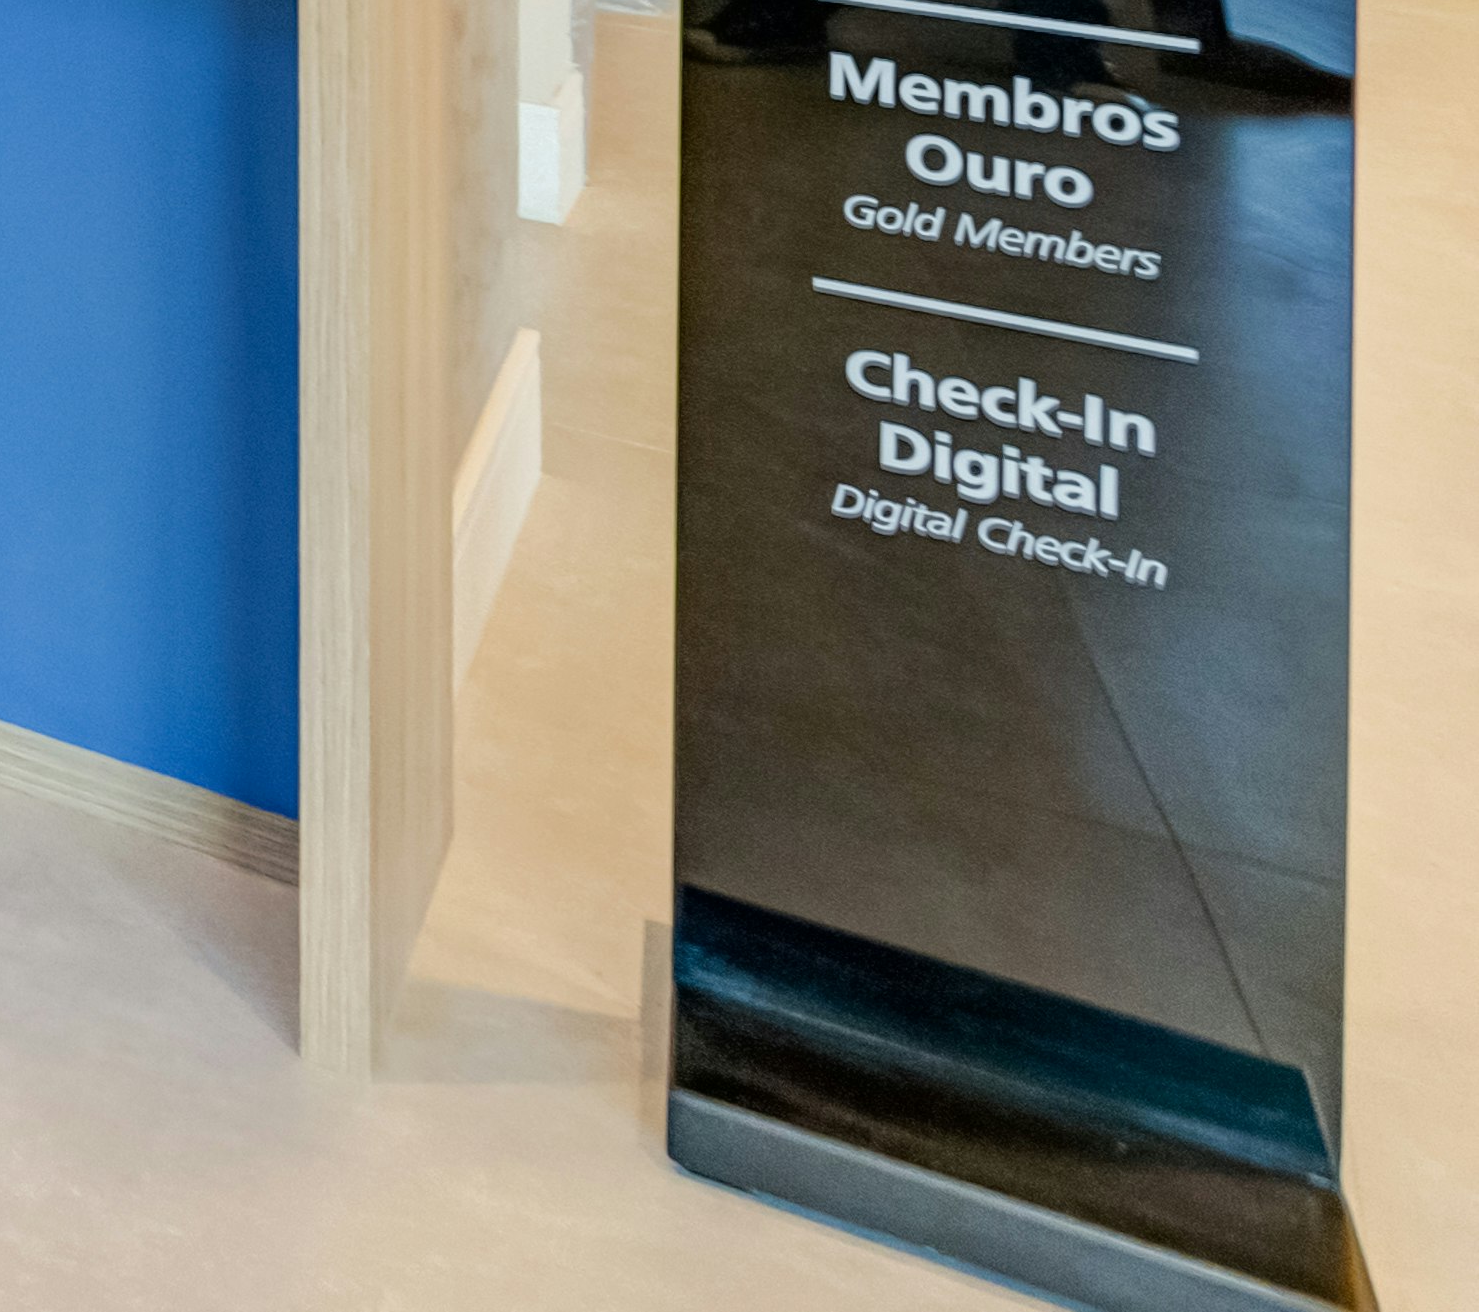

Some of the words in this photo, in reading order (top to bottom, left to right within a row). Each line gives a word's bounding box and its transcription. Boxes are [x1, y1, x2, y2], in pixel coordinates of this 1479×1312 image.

[827, 52, 1181, 150] Membros
[905, 134, 1095, 208] Ouro
[843, 195, 944, 244] Gold
[953, 214, 1162, 280] Members
[845, 350, 1157, 456] Check-In
[878, 421, 1120, 520] Digital
[831, 484, 967, 544] Digital
[977, 516, 1168, 589] Check-In
